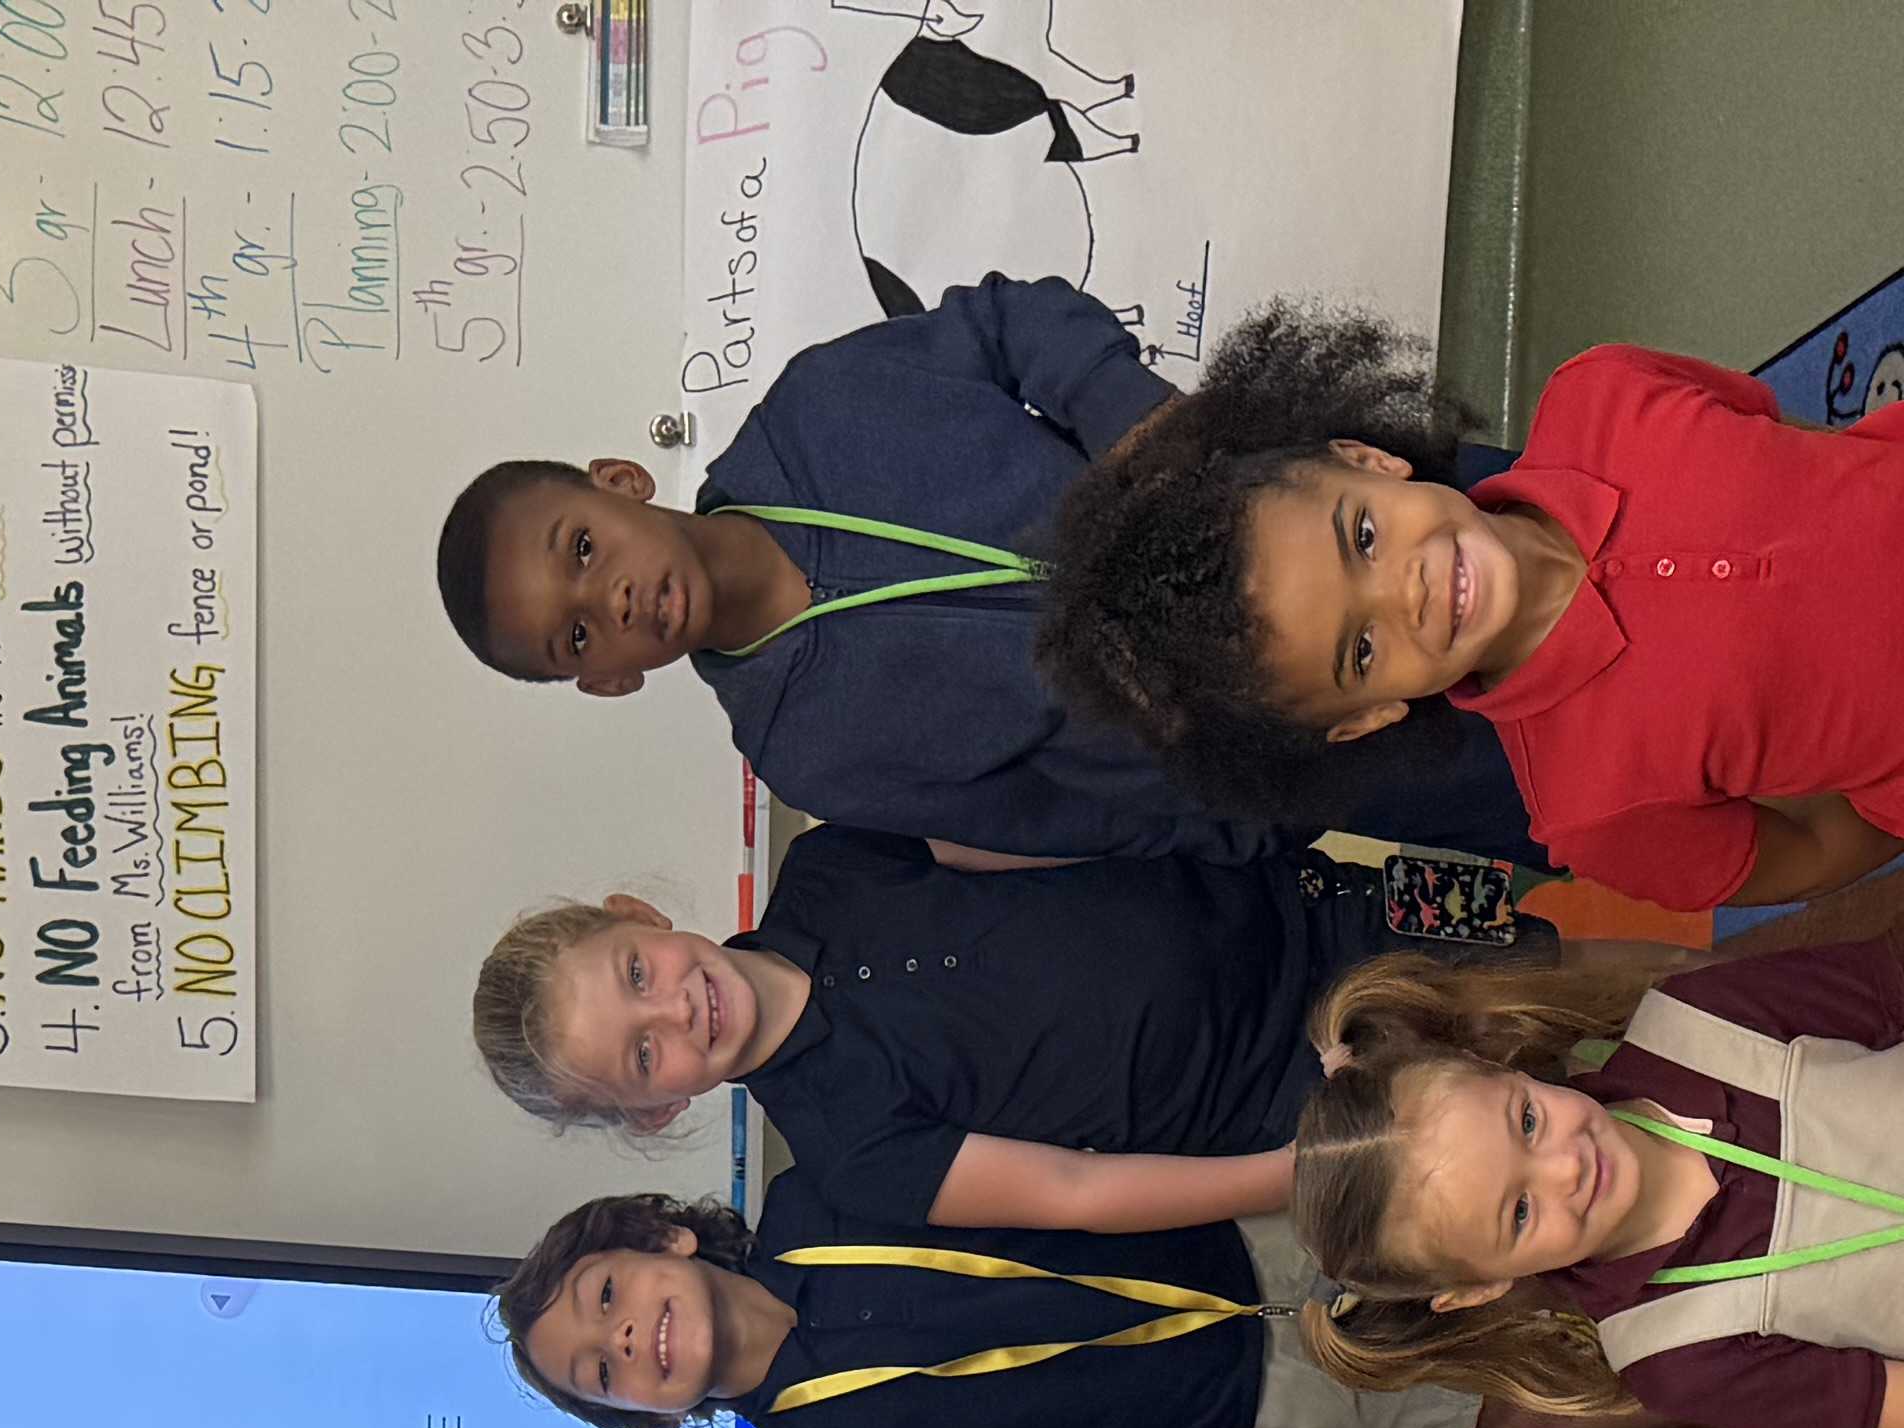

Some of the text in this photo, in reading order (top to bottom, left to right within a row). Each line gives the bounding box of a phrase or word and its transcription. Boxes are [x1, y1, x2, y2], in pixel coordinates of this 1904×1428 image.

[697, 25, 828, 144] Pig
[742, 157, 767, 198] a
[98, 207, 175, 352] Lunch
[1176, 279, 1202, 338] Hoof
[682, 250, 759, 393] Parts
[170, 429, 230, 512] pond!
[40, 460, 83, 565] without
[184, 520, 214, 550] or
[178, 569, 222, 645] fence
[21, 581, 88, 728] Animals
[31, 742, 116, 891] Feeding
[170, 665, 230, 920] CLIMBING
[35, 919, 99, 986] NO
[111, 923, 152, 1001] from
[174, 932, 237, 996] NO
